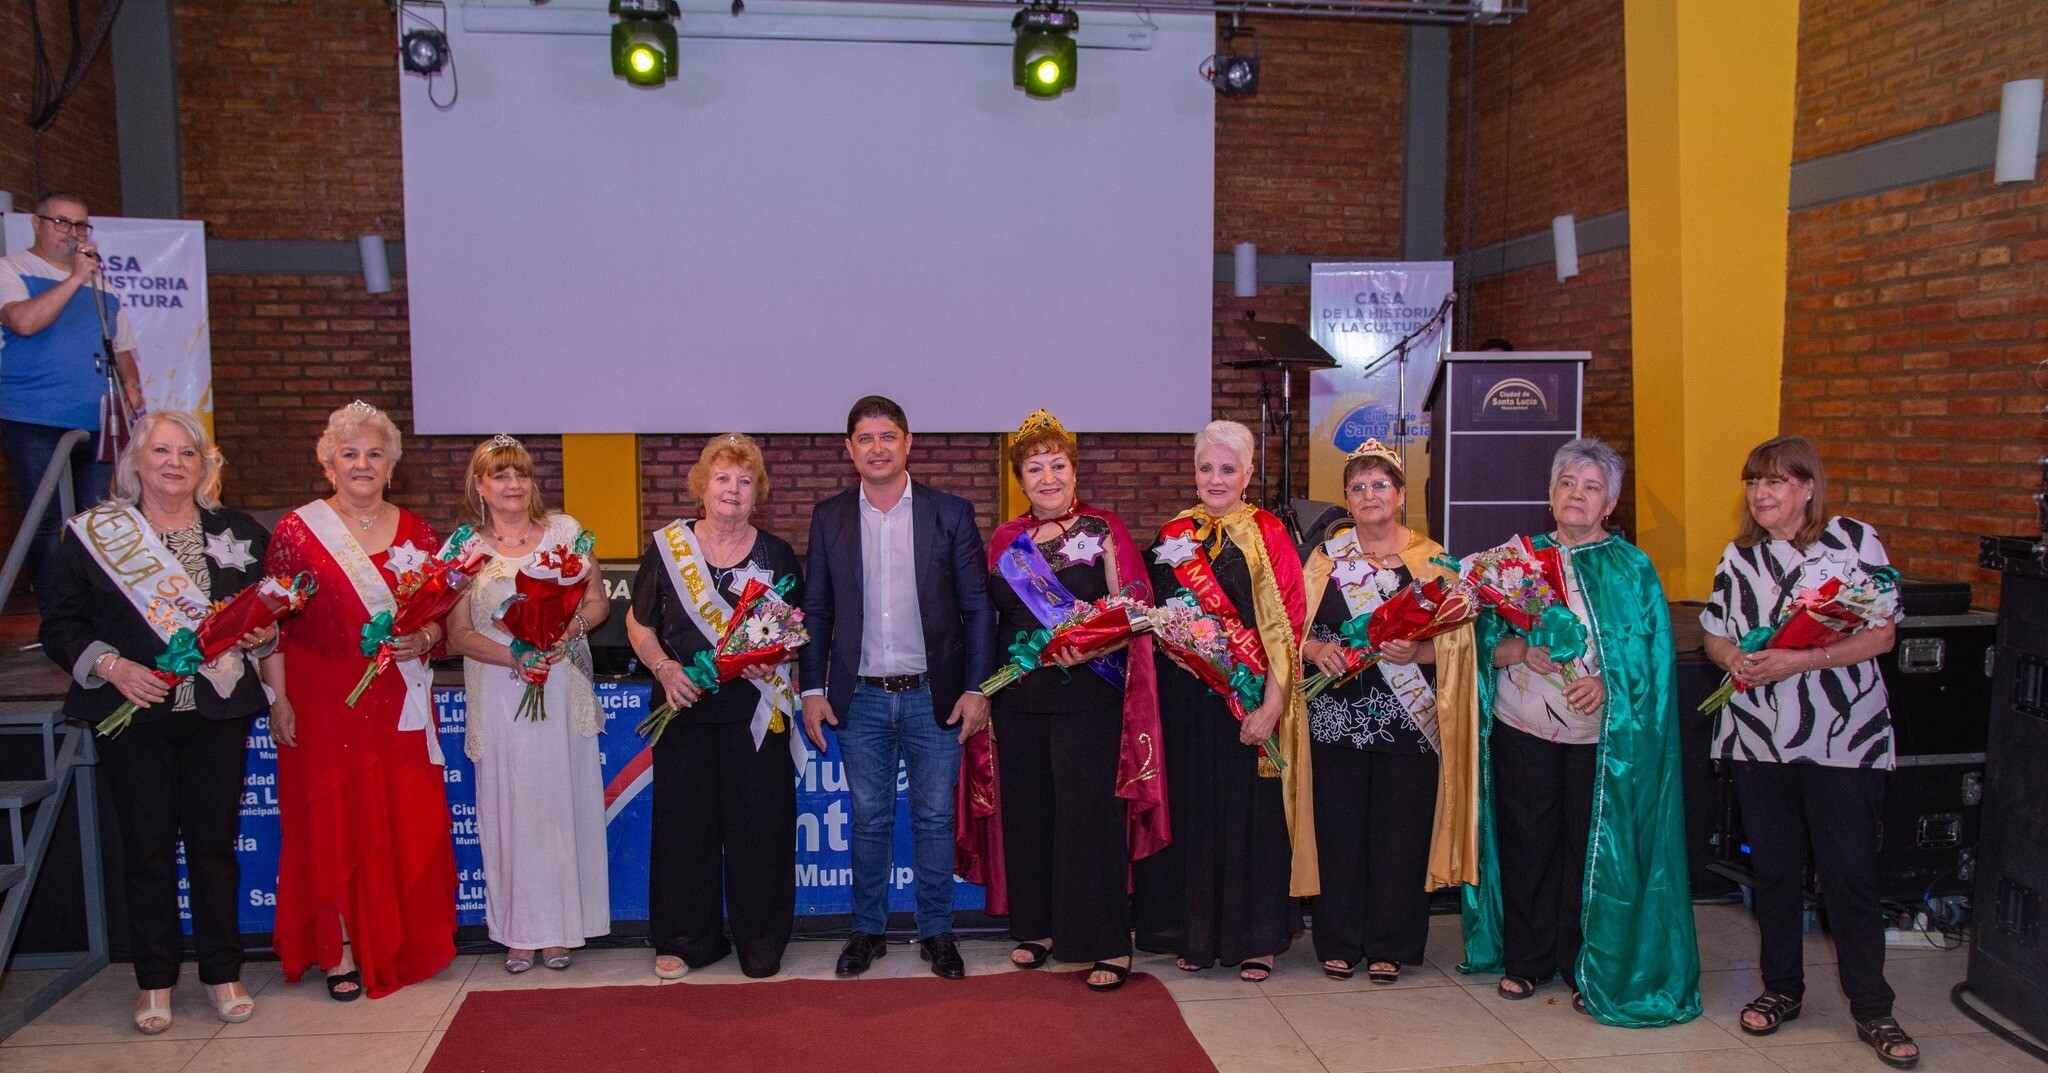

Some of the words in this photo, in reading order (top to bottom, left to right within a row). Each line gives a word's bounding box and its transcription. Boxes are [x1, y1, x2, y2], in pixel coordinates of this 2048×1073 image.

[1355, 292, 1404, 305] CASA
[1323, 309, 1342, 319] DE
[1346, 309, 1364, 319] LA
[1370, 308, 1437, 319] HISTORIA
[1328, 323, 1337, 333] Y
[1342, 323, 1361, 333] LA
[1346, 422, 1388, 437] Santa
[1077, 540, 1085, 550] 6
[407, 554, 413, 565] 2
[664, 523, 692, 562] LUZ
[680, 563, 707, 605] DEL
[1349, 562, 1356, 572] 8
[1820, 569, 1828, 581] 5
